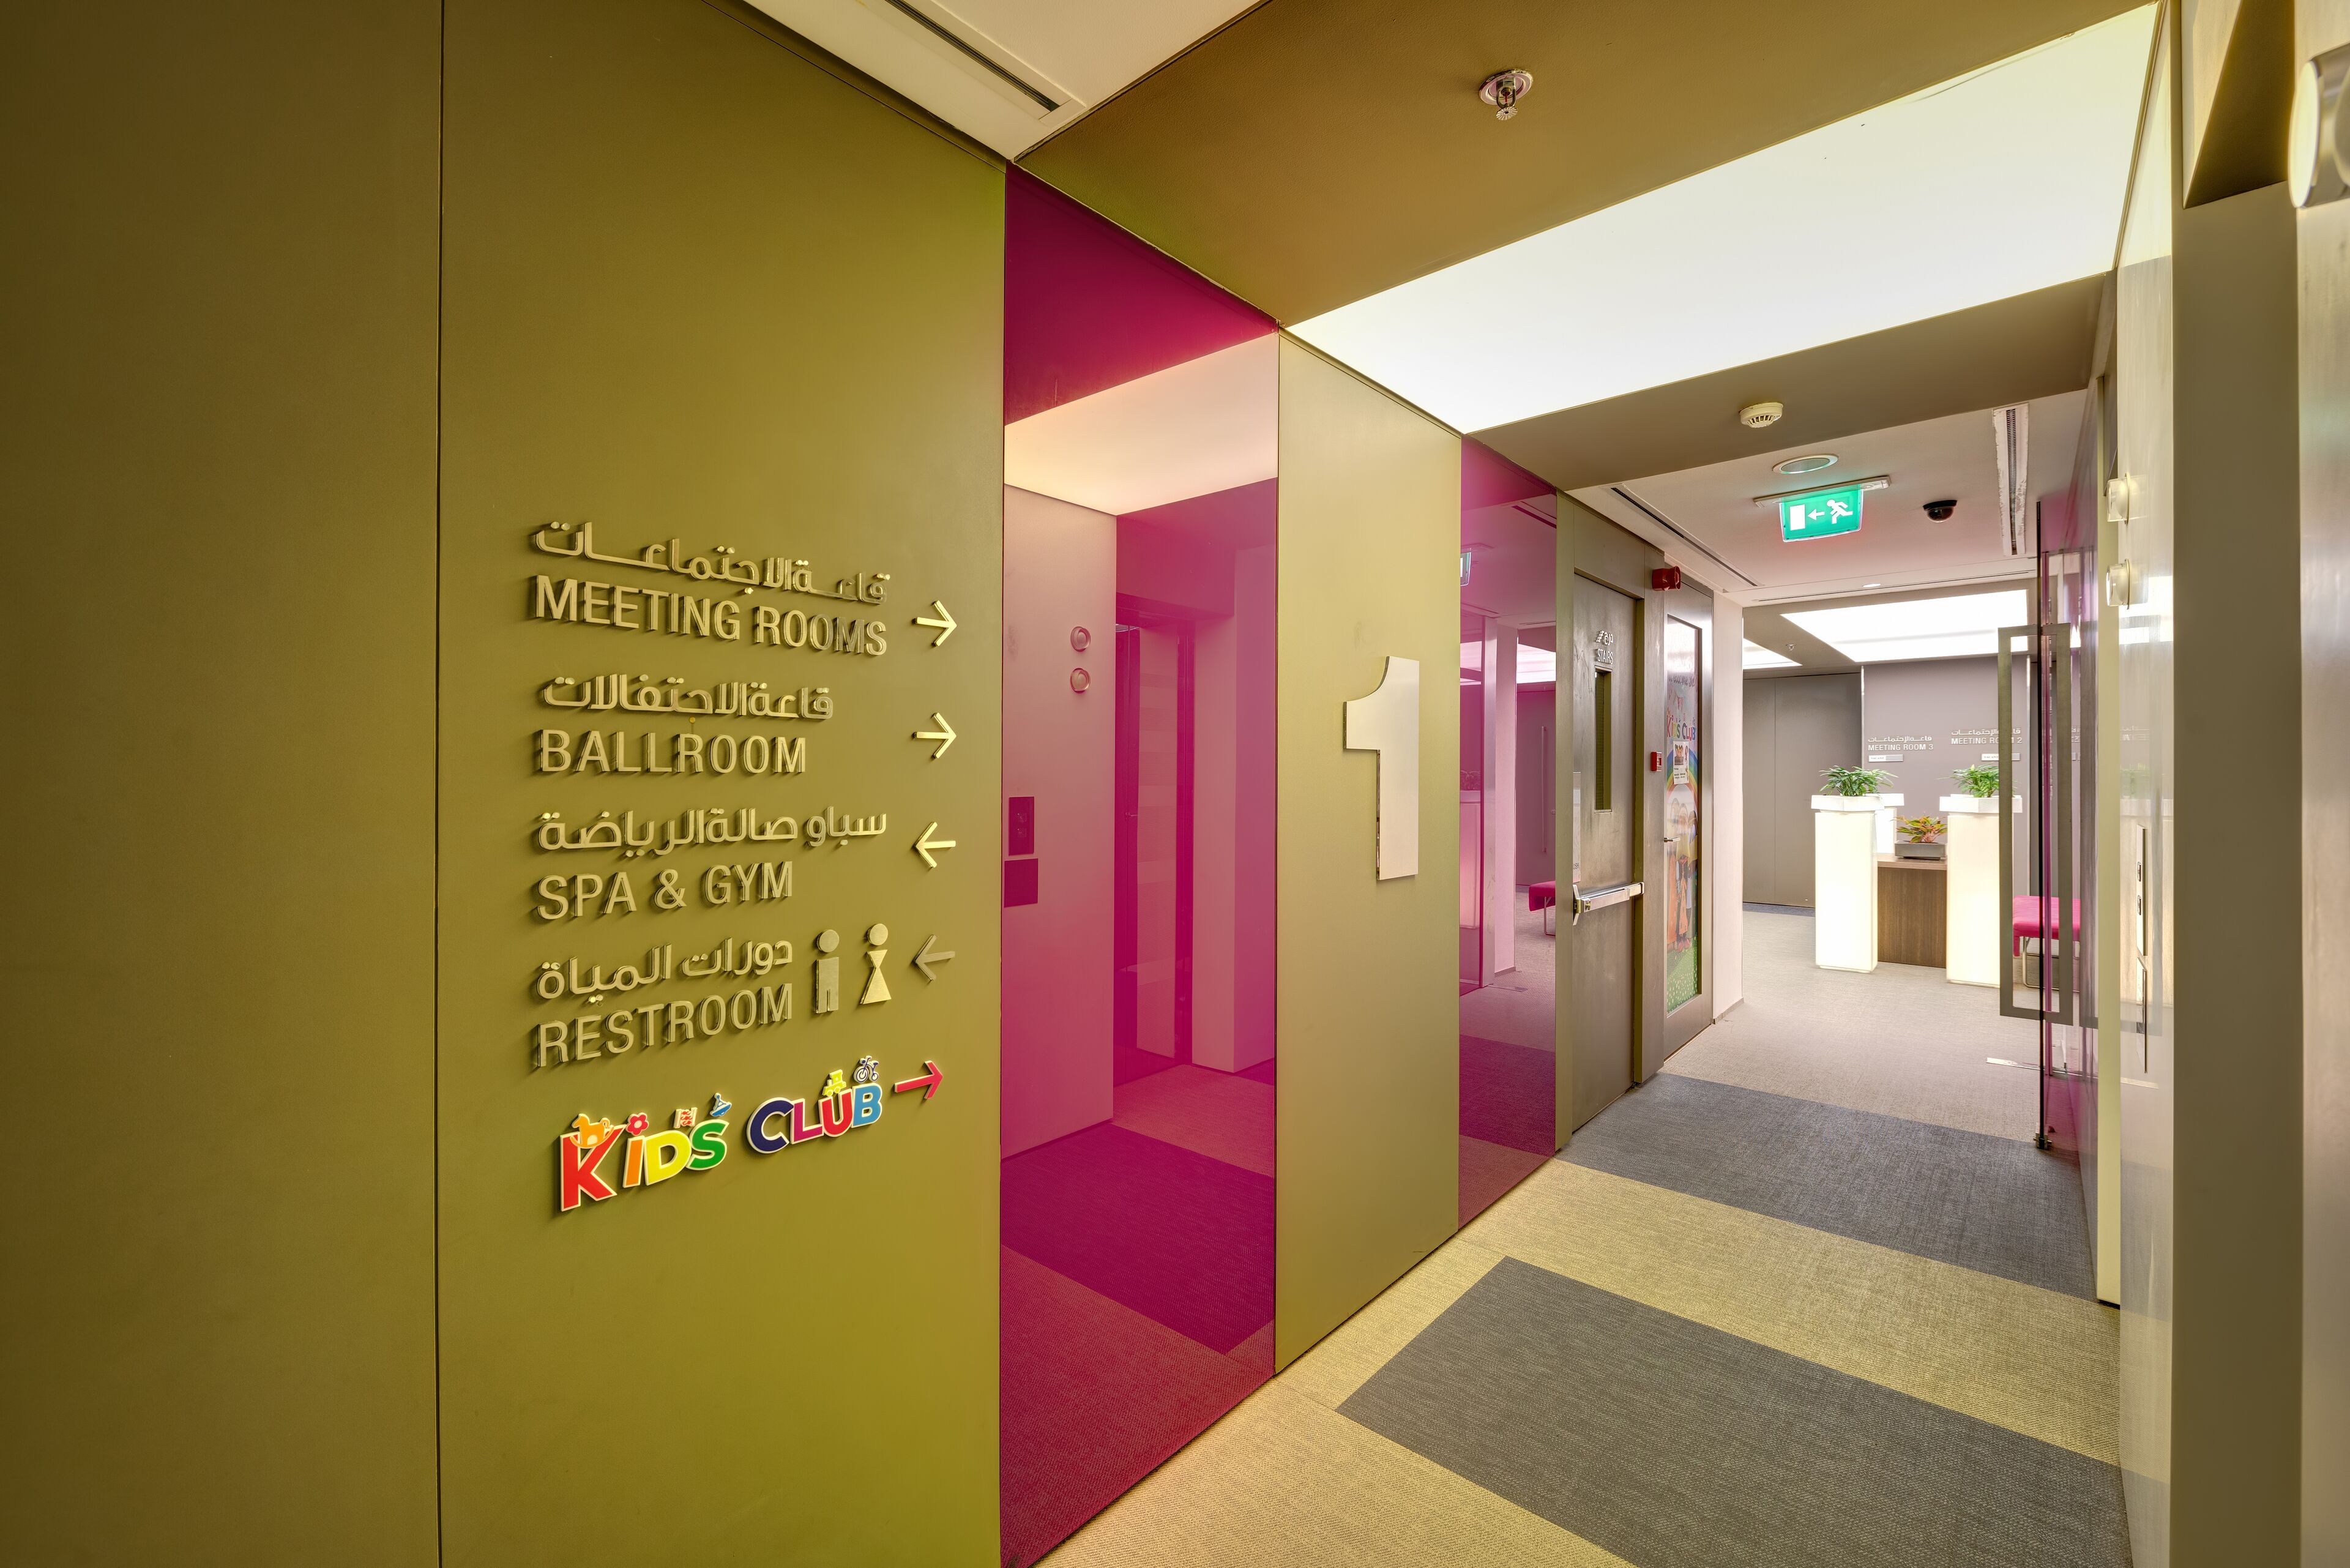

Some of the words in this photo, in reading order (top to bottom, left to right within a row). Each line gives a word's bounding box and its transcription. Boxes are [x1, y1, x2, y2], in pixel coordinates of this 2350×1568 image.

[536, 574, 740, 641] MEETING
[755, 605, 887, 656] ROOMS
[1597, 648, 1614, 665] STAIRS
[540, 729, 806, 774] BALLROOM
[1682, 722, 1695, 741] CLUB
[1343, 655, 1420, 881] 1
[537, 871, 638, 920] SPA
[654, 868, 687, 909] &
[704, 861, 793, 905] GYM
[681, 937, 793, 977] دورات
[537, 982, 793, 1068] RESTROOM
[746, 1082, 883, 1155] CLUB
